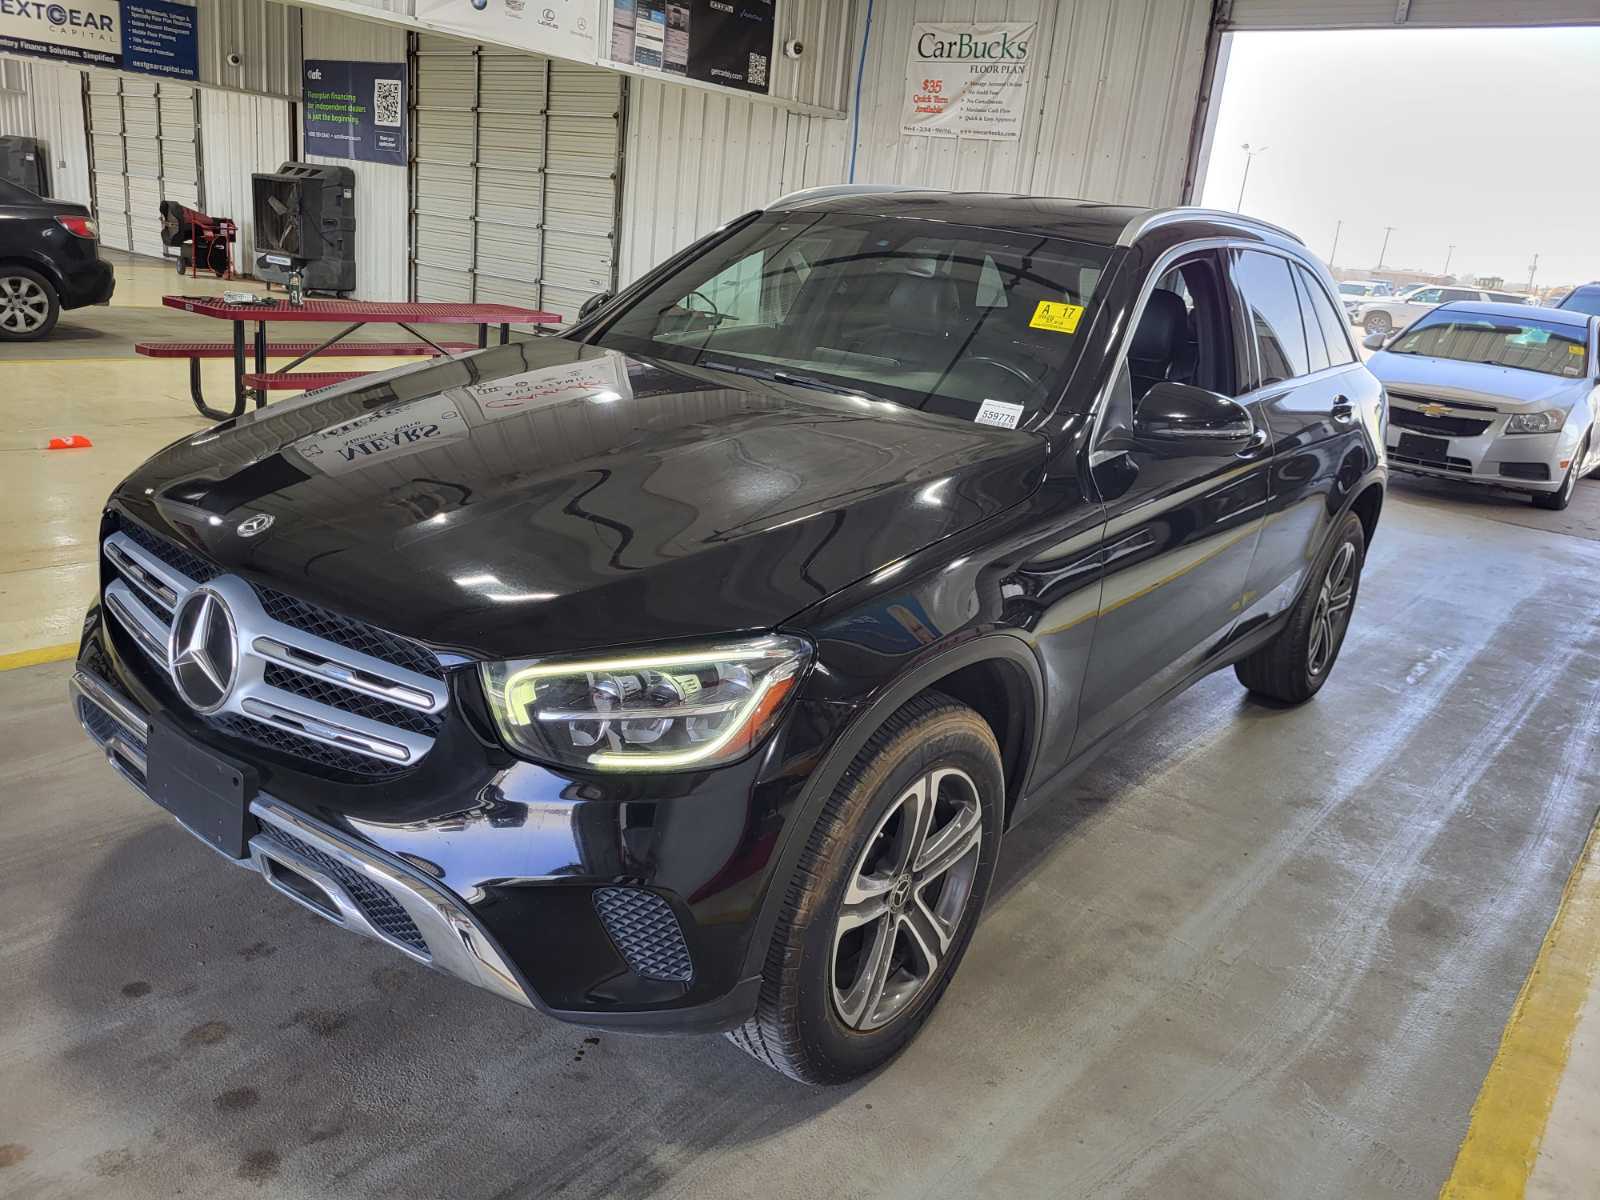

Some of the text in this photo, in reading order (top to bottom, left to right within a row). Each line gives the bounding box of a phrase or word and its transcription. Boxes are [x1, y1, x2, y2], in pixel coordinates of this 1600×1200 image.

[49, 25, 117, 42] CAPITAL
[20, 41, 47, 52] Finance
[917, 32, 1028, 59] CarBucks
[970, 65, 1025, 75] FLOOR PLAN
[1041, 304, 1076, 318] A 17
